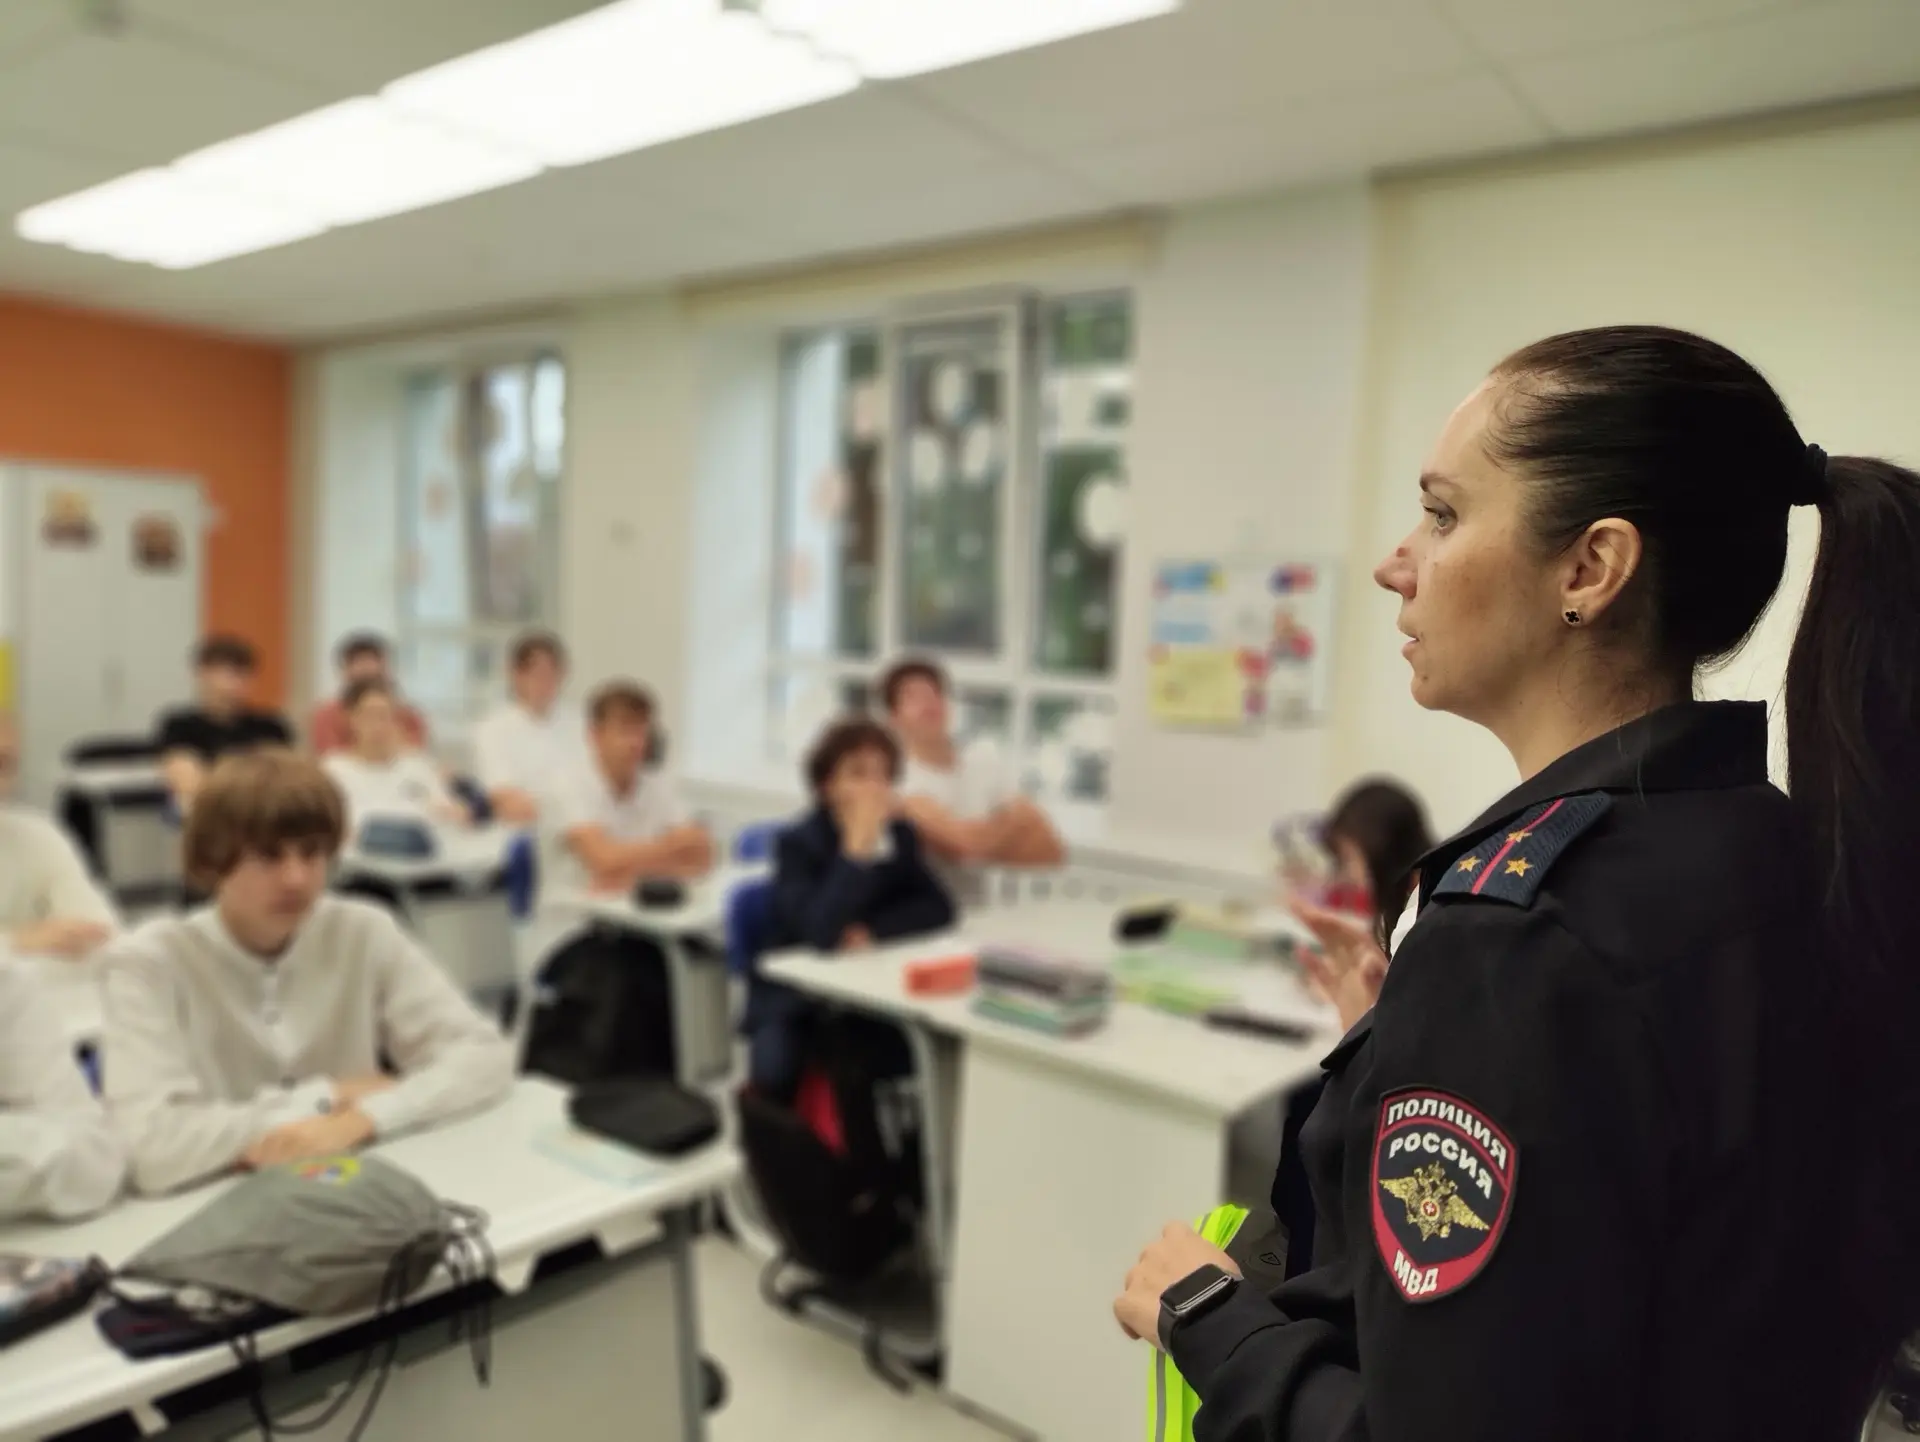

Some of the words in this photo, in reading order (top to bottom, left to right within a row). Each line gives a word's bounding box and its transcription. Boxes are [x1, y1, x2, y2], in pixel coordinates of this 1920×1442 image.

[1388, 1098, 1507, 1169] ПОЛИЦИЯ
[1389, 1133, 1493, 1199] РОССИЯ
[1394, 1250, 1439, 1295] МВД
